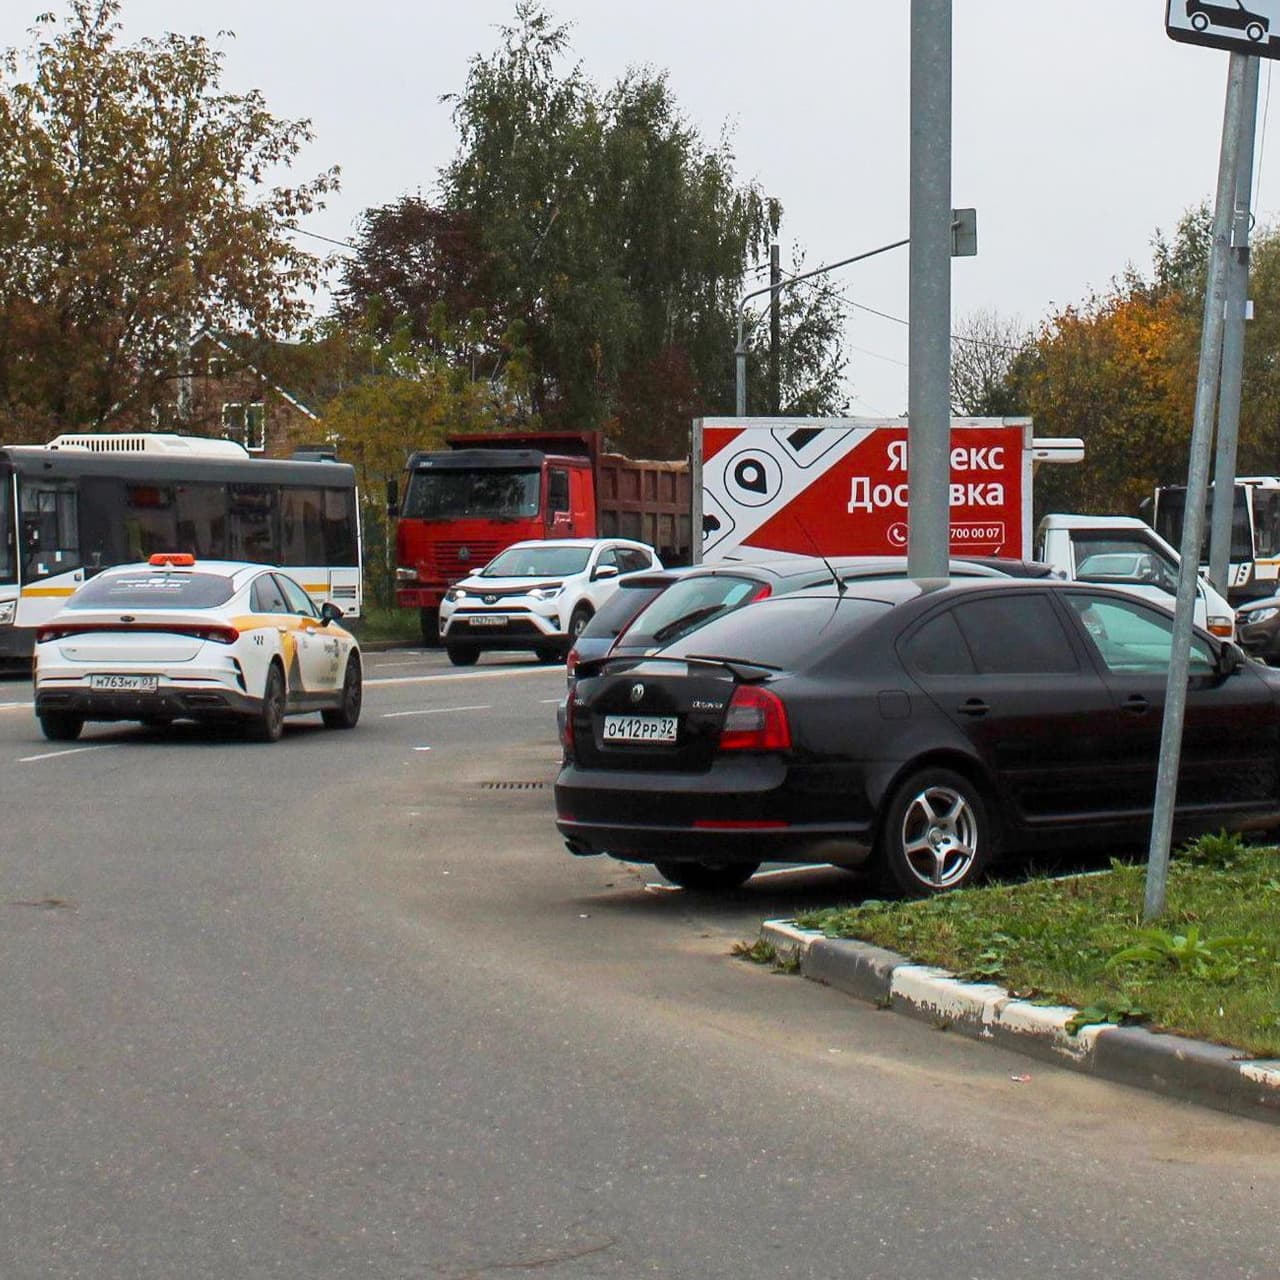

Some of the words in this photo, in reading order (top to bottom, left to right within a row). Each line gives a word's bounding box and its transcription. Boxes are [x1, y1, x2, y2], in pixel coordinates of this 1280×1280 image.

[887, 440, 1005, 471] Яекс
[847, 476, 1005, 514] Досвка
[970, 527, 985, 539] 00
[986, 527, 1000, 538] 07
[660, 720, 674, 735] 32
